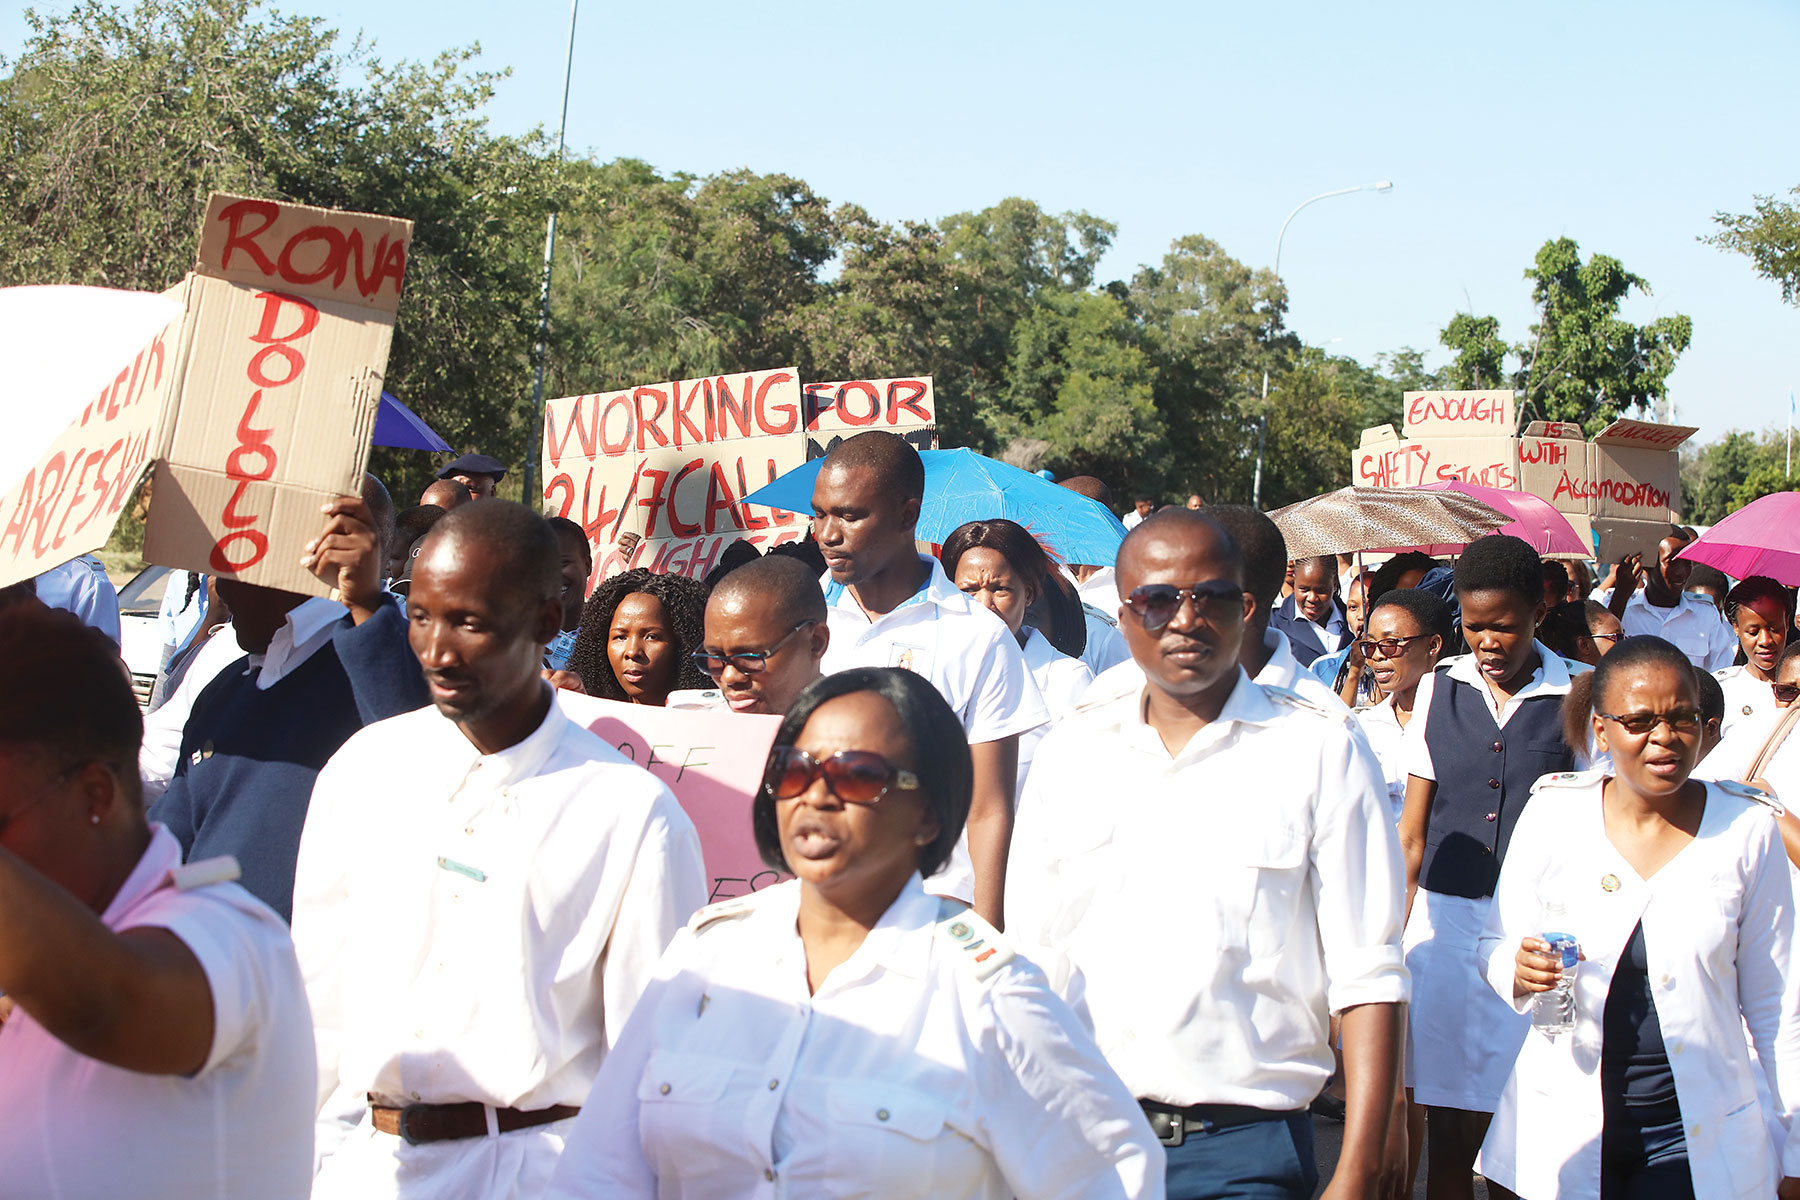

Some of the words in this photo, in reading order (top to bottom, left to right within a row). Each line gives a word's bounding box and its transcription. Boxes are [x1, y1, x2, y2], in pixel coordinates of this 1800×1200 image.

[218, 200, 405, 300] RONA
[210, 289, 320, 574] DOLOLO
[546, 372, 798, 468] WORKING
[804, 380, 932, 432] FOR
[1408, 396, 1504, 426] ENOUGH
[1543, 422, 1563, 438] IS
[1360, 444, 1431, 488] SAFETY
[1519, 440, 1567, 465] WITH
[1553, 469, 1670, 508] ACCOMODATION
